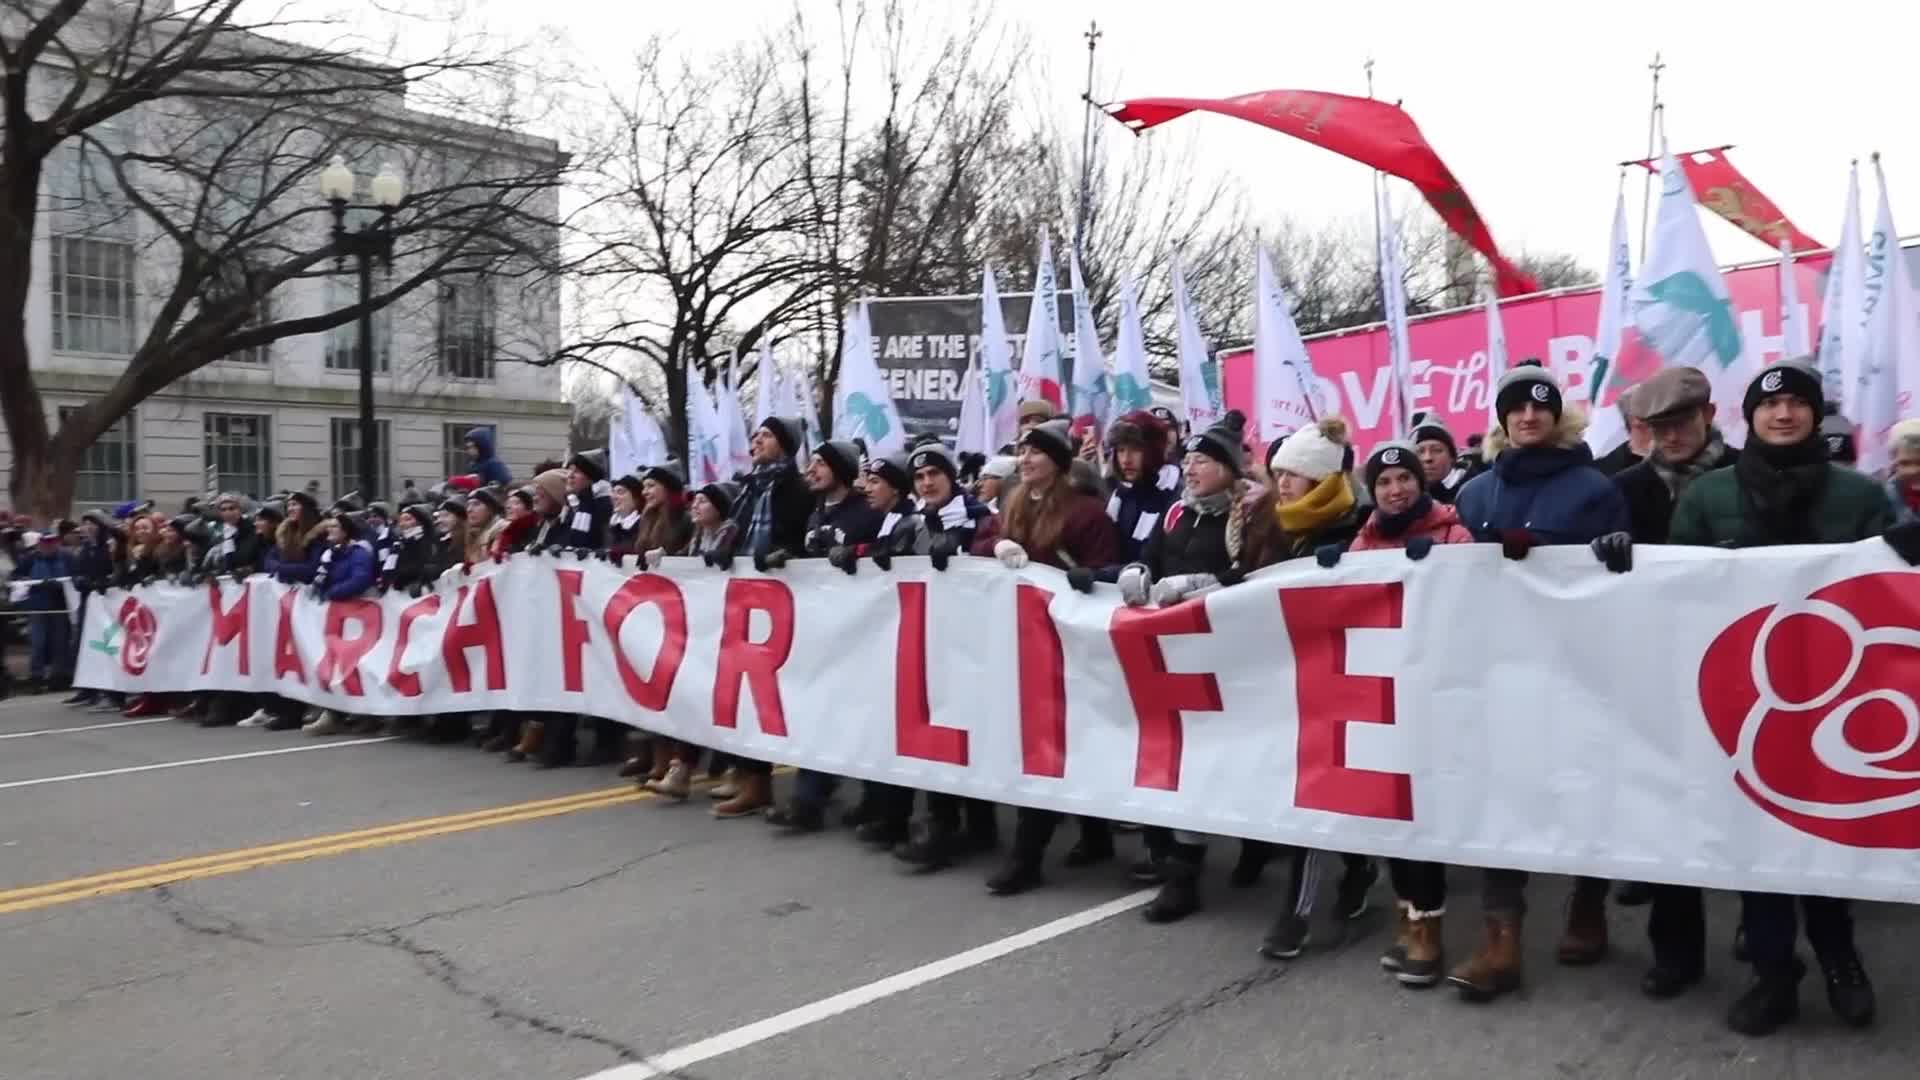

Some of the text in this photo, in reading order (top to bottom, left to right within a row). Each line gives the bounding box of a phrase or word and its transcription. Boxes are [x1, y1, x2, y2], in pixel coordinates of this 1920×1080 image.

[883, 335, 923, 359] ARE
[927, 335, 966, 359] THE
[200, 569, 1414, 821] MARCH FOR LIFE
